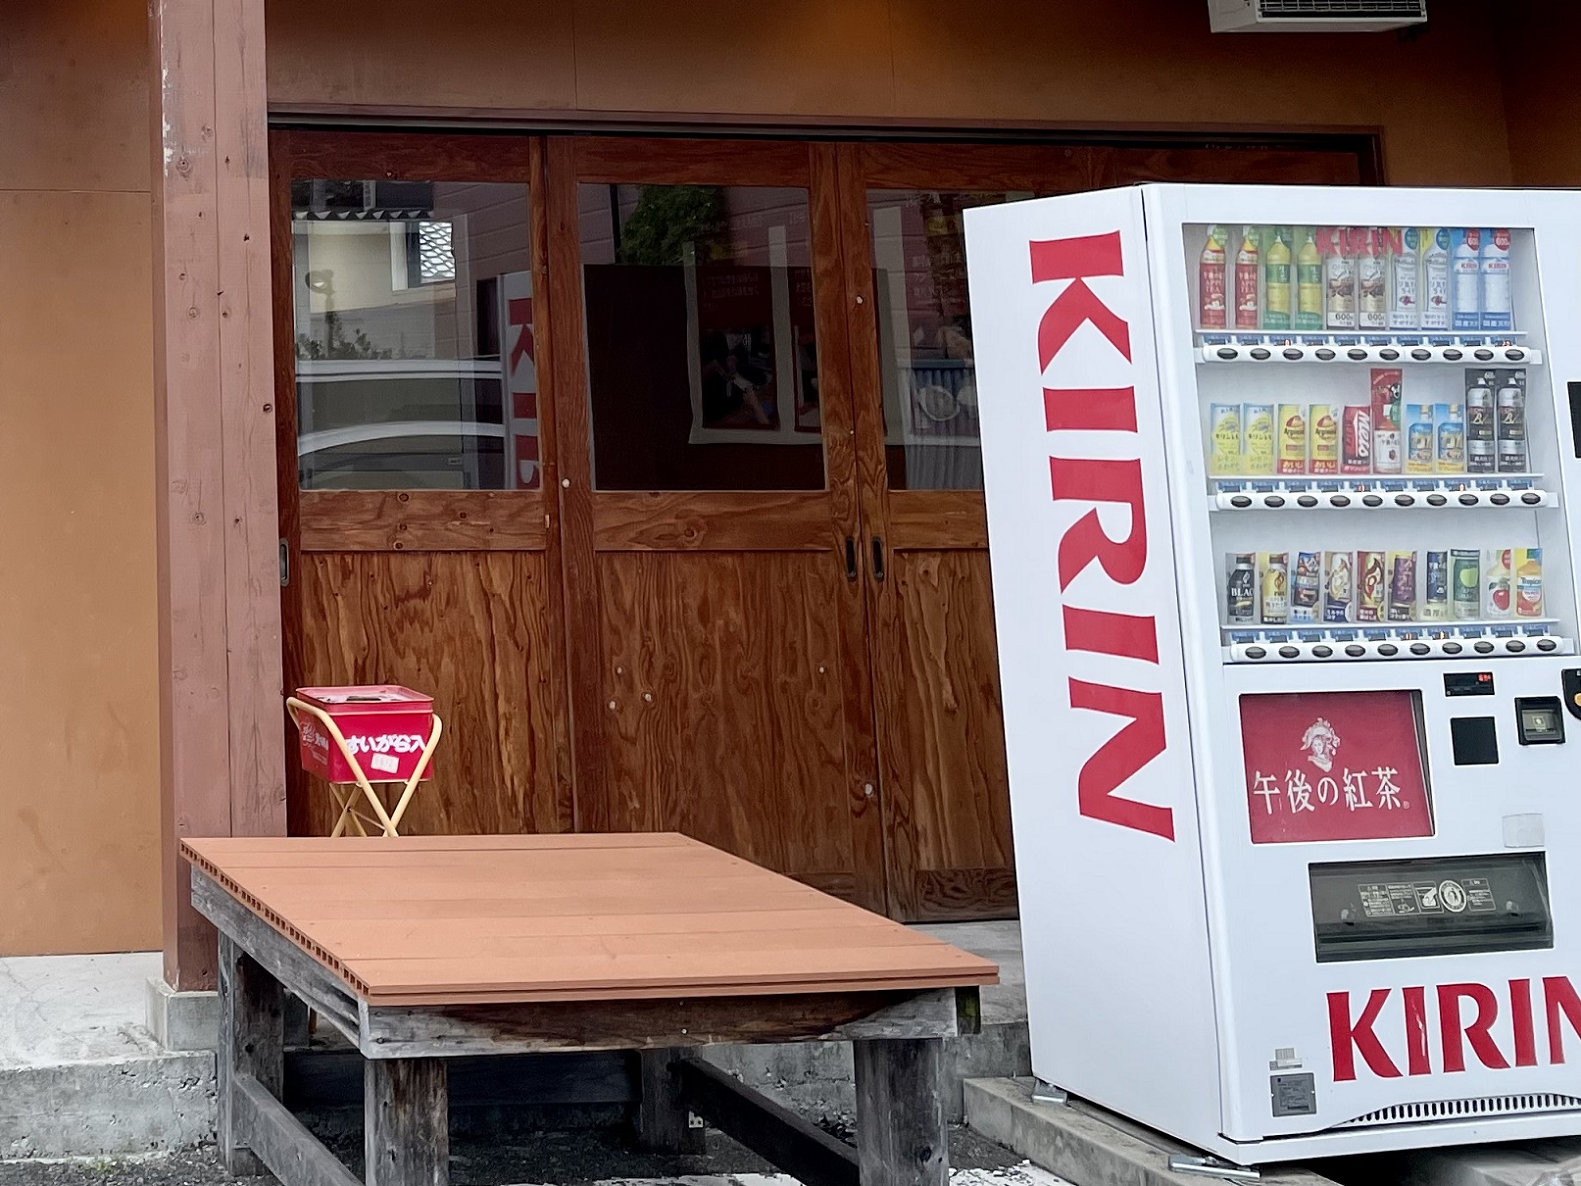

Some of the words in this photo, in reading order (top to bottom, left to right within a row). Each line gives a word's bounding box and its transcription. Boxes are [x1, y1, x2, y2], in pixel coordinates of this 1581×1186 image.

[1029, 230, 1175, 843] KIRIN
[1253, 767, 1401, 815] 午後の紅茶
